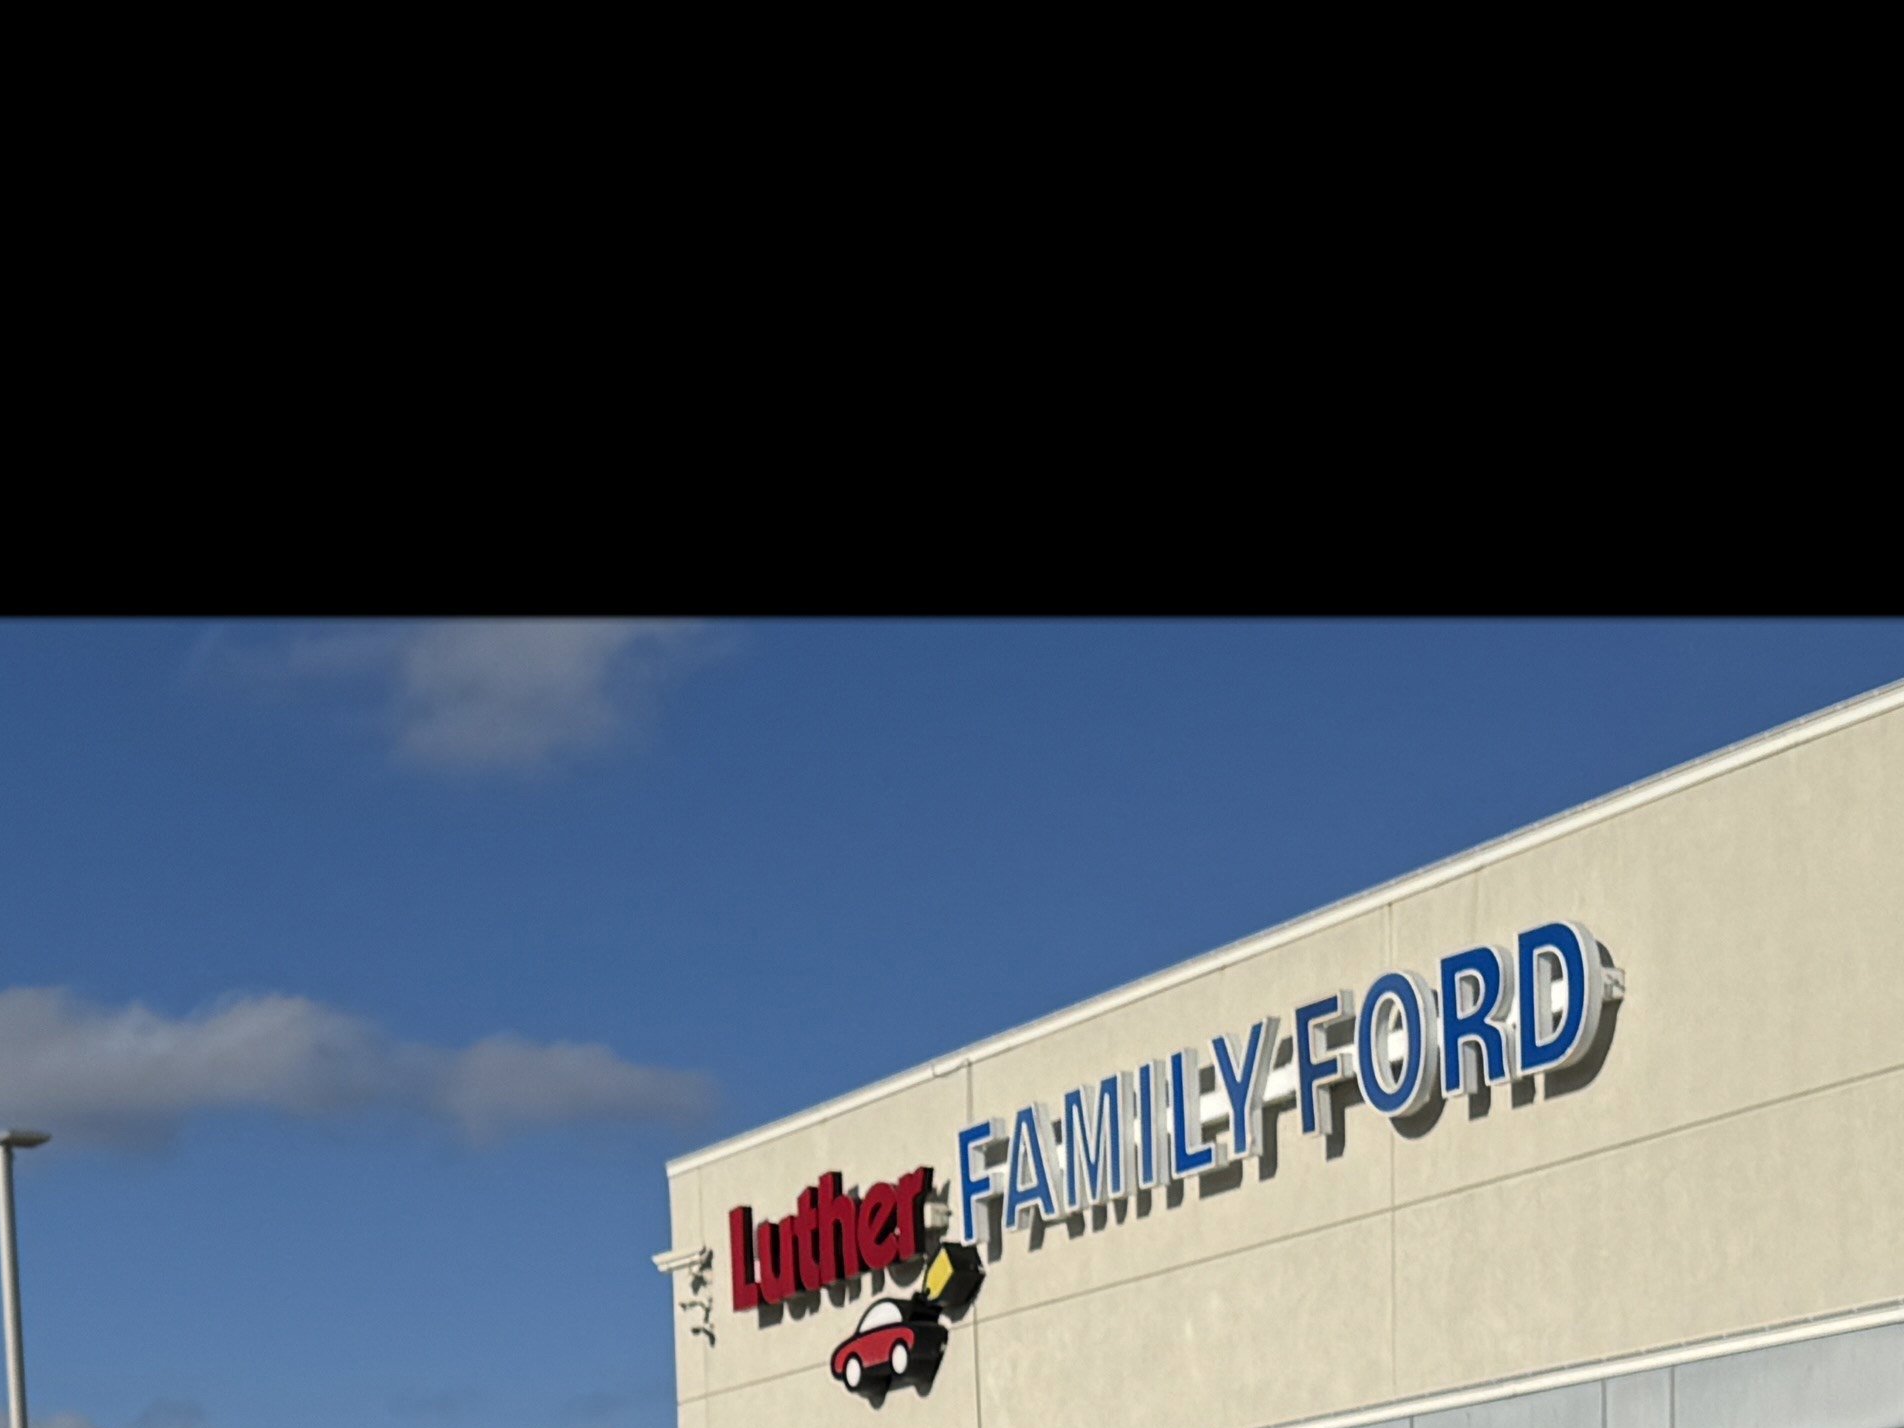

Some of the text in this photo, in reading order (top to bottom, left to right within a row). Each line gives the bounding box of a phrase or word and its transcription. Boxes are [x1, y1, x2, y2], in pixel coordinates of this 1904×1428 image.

[729, 920, 1602, 1312] Luther FAMILY FORD
